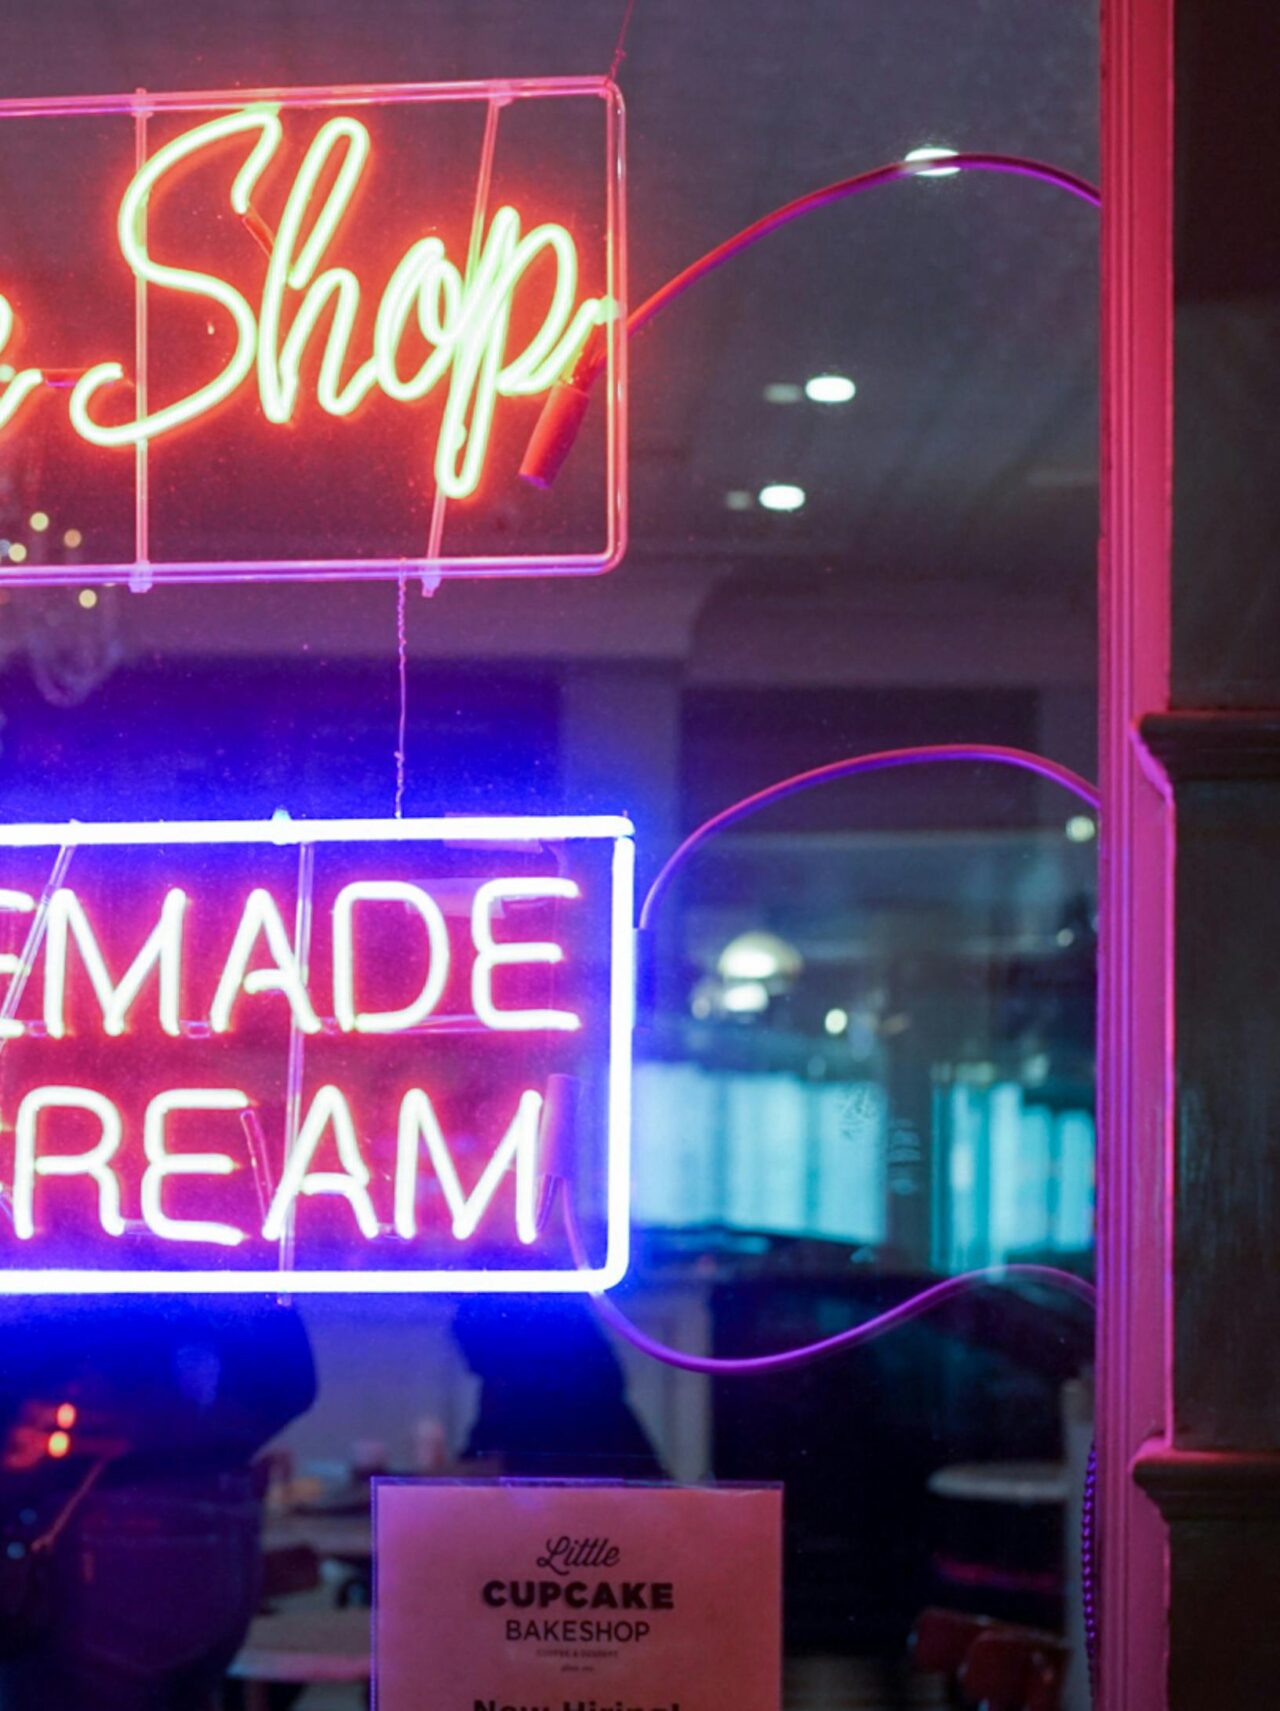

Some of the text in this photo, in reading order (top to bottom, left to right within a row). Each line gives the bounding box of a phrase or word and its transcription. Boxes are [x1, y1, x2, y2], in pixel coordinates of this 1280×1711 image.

[69, 106, 608, 499] Shop
[536, 1535, 620, 1576] Little
[482, 1580, 674, 1611] CUPCAKE
[505, 1619, 650, 1643] BAKESHOP
